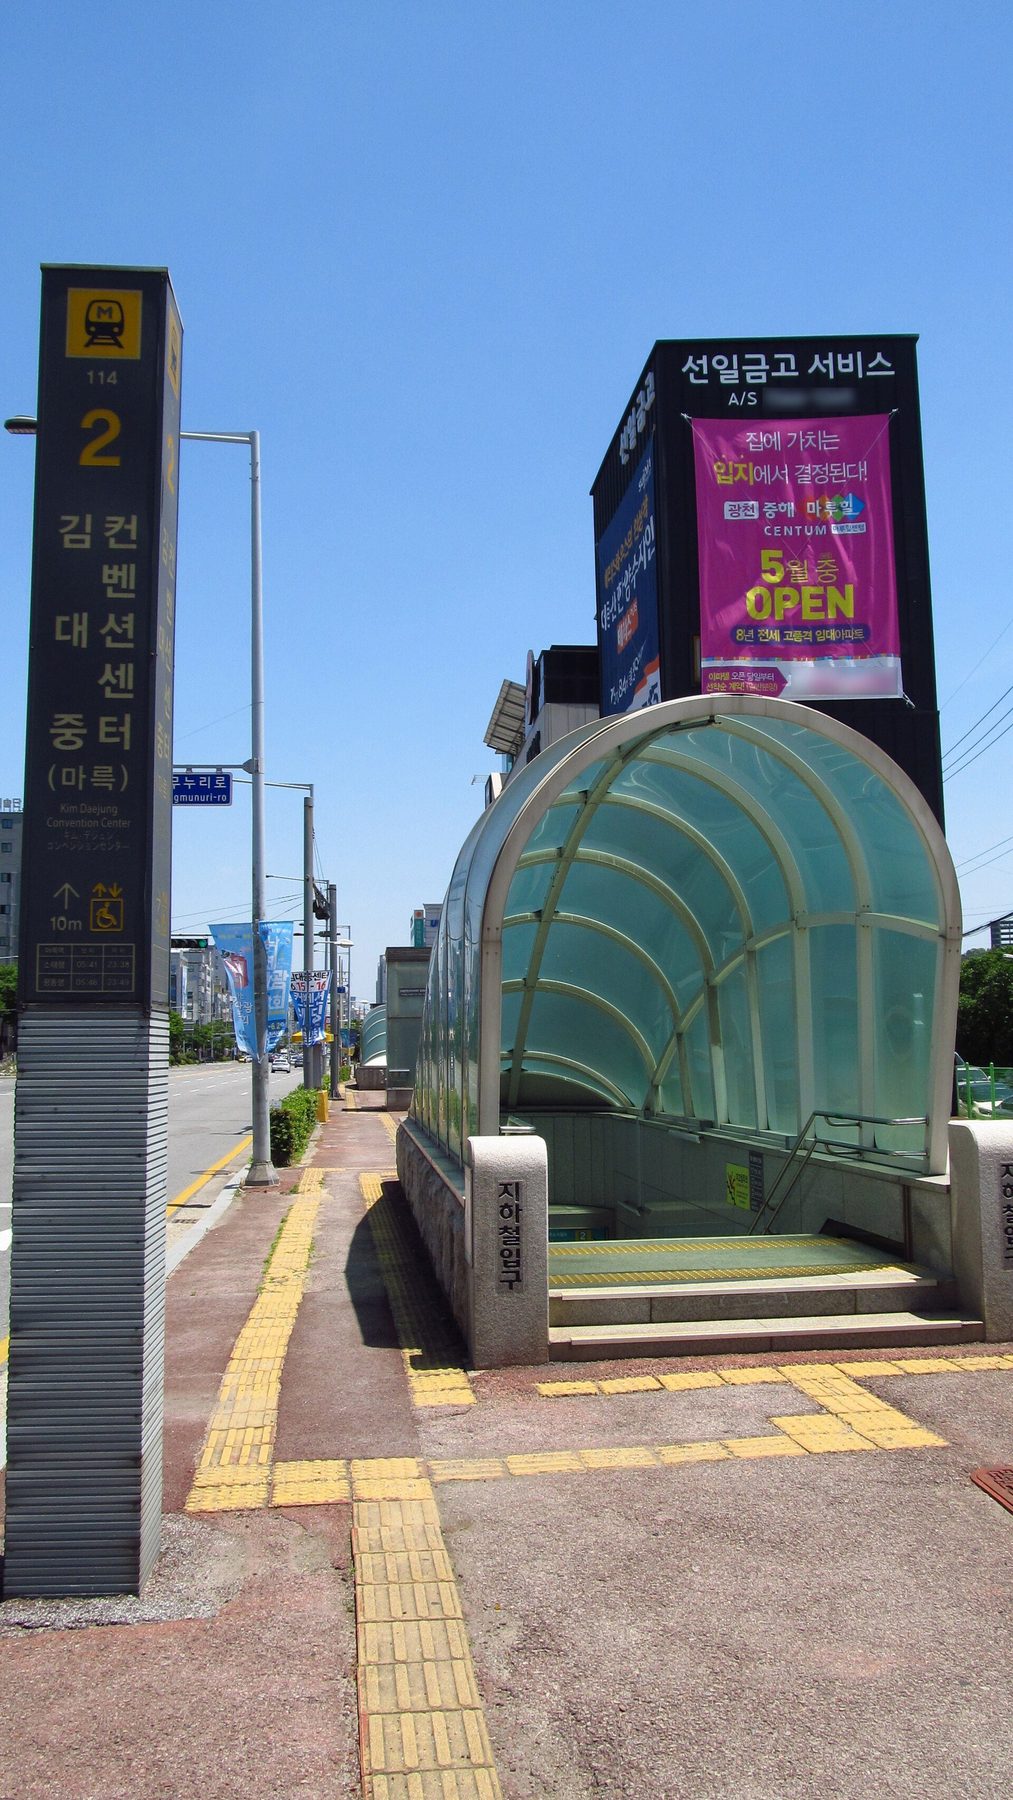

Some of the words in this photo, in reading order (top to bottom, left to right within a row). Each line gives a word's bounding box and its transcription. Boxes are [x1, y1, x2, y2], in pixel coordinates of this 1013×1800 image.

[681, 353, 800, 384] 선일금고
[807, 351, 896, 379] 서비스
[86, 370, 118, 386] 114
[728, 391, 759, 407] A/S
[78, 408, 122, 467] 2
[745, 431, 781, 452] 집에
[787, 431, 841, 452] 가치는
[713, 458, 790, 486] 입지에서
[793, 460, 868, 485] 결정된다!
[727, 501, 757, 518] 광천
[762, 502, 795, 519] 중해
[764, 525, 827, 536] CENTUM
[760, 549, 809, 584] 5월
[815, 554, 839, 583] 중
[745, 583, 855, 622] OPEN
[735, 628, 755, 642] 8년
[757, 629, 781, 643] 전세
[783, 630, 813, 643] 고품격
[815, 628, 865, 642] 임대아파트
[48, 763, 129, 793] (마륵)
[172, 776, 227, 790] 무누리로
[173, 792, 227, 804] gmunuri-ro
[60, 803, 78, 814] Kim
[80, 803, 118, 817] Daejung
[47, 817, 99, 828] Convention
[101, 817, 131, 828] Center
[50, 916, 83, 931] 10m
[498, 1181, 523, 1291] 지하철입구
